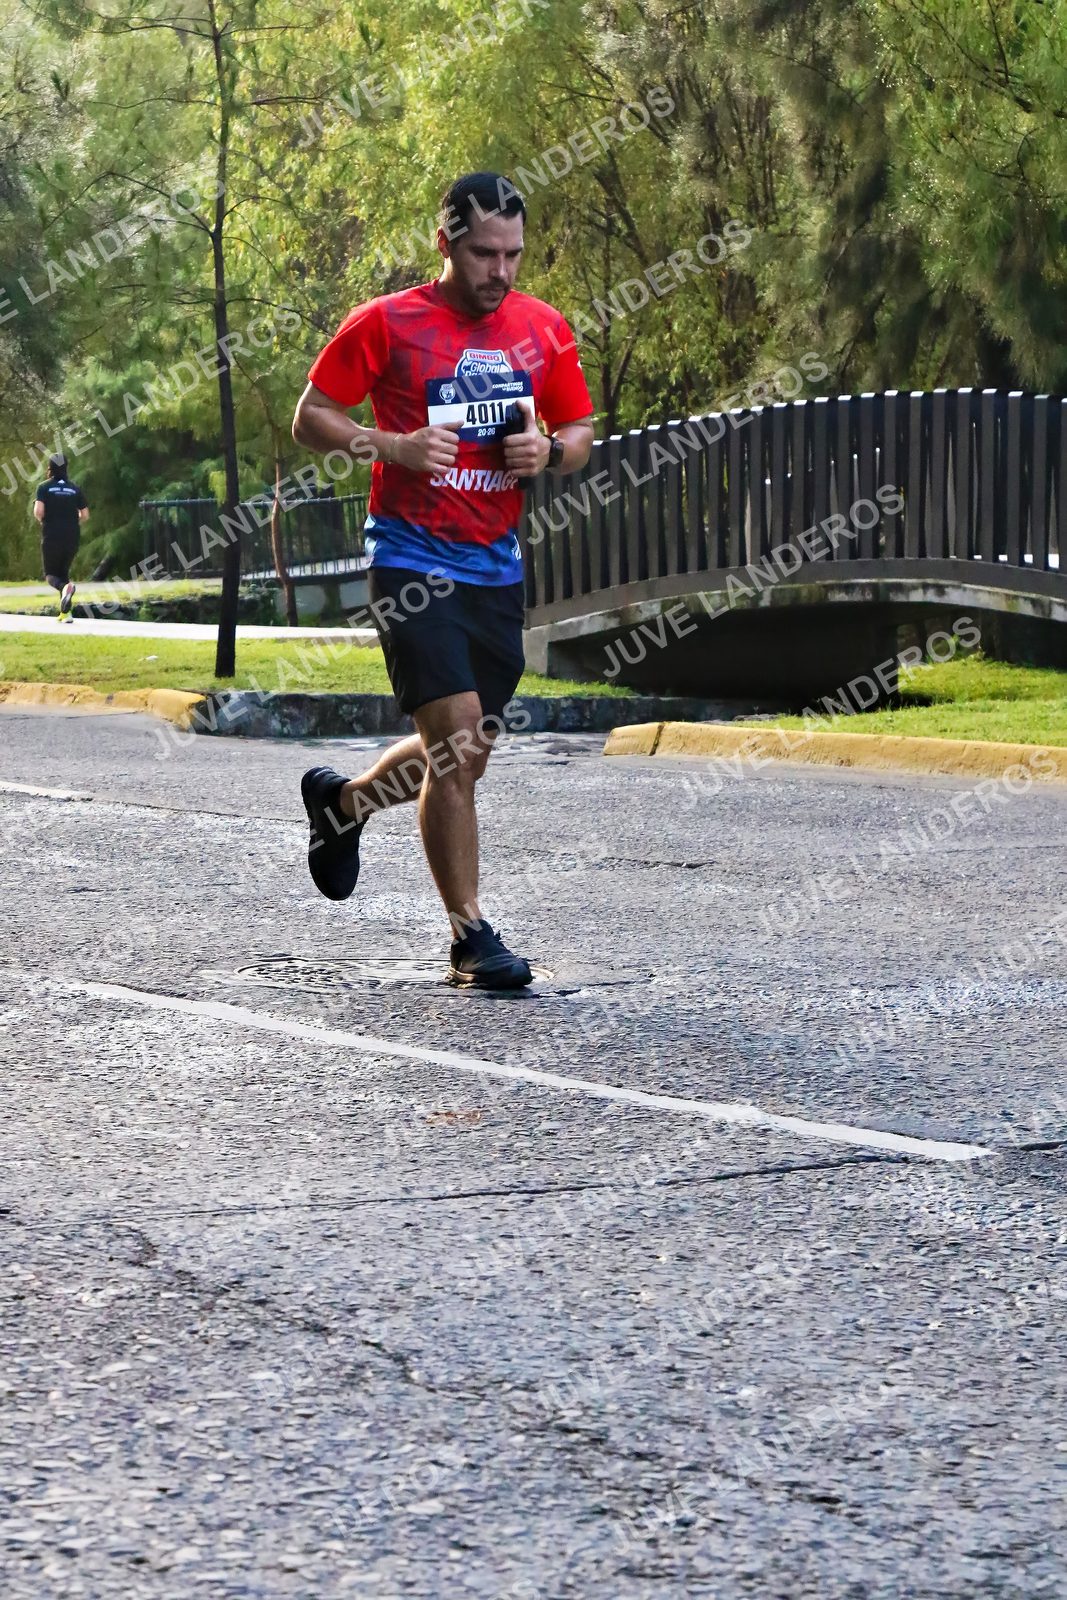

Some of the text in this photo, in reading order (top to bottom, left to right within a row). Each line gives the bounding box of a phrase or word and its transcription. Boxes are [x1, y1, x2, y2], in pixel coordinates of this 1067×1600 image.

[469, 353, 500, 362] BIMBO
[470, 362, 500, 374] Global
[466, 401, 505, 425] 4011
[430, 467, 518, 492] SANTIAG
